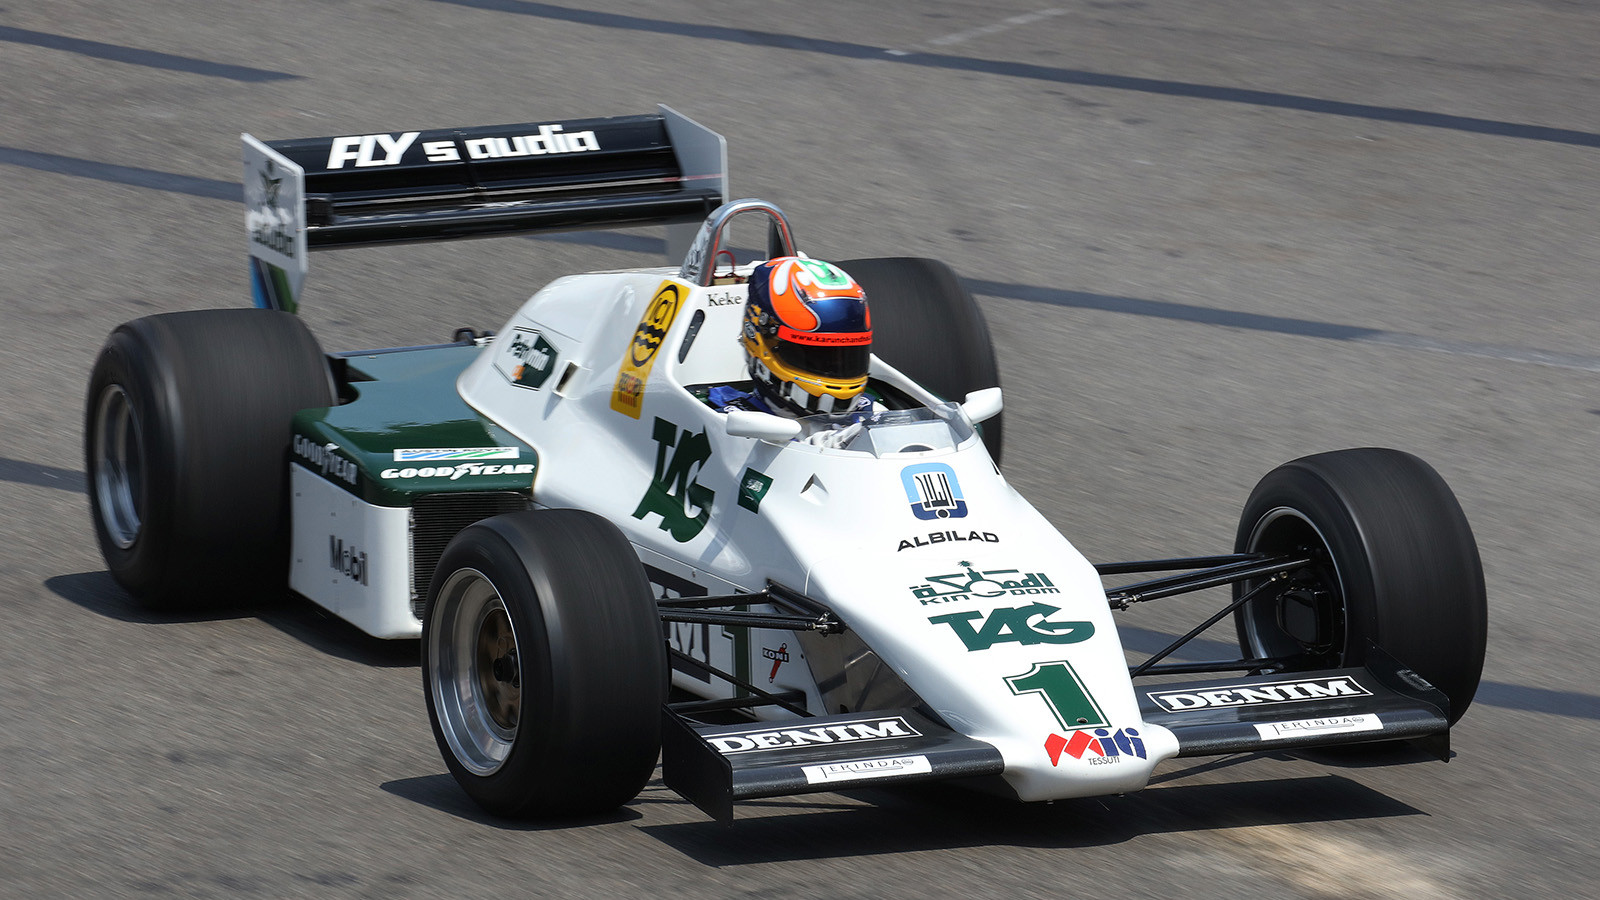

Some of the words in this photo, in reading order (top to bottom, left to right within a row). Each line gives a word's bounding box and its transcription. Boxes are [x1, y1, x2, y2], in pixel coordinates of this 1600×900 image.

[326, 131, 421, 171] FLY
[707, 292, 743, 308] Keke
[380, 463, 535, 480] GOODYEAR
[631, 415, 717, 543] TAG
[896, 530, 1000, 553] ALBILAD
[927, 600, 1096, 652] TAG
[763, 648, 789, 663] KONI
[1002, 659, 1112, 732] 1
[1158, 680, 1362, 710] DENIM
[707, 720, 910, 753] DENIM
[1087, 756, 1120, 766] TESSUTI
